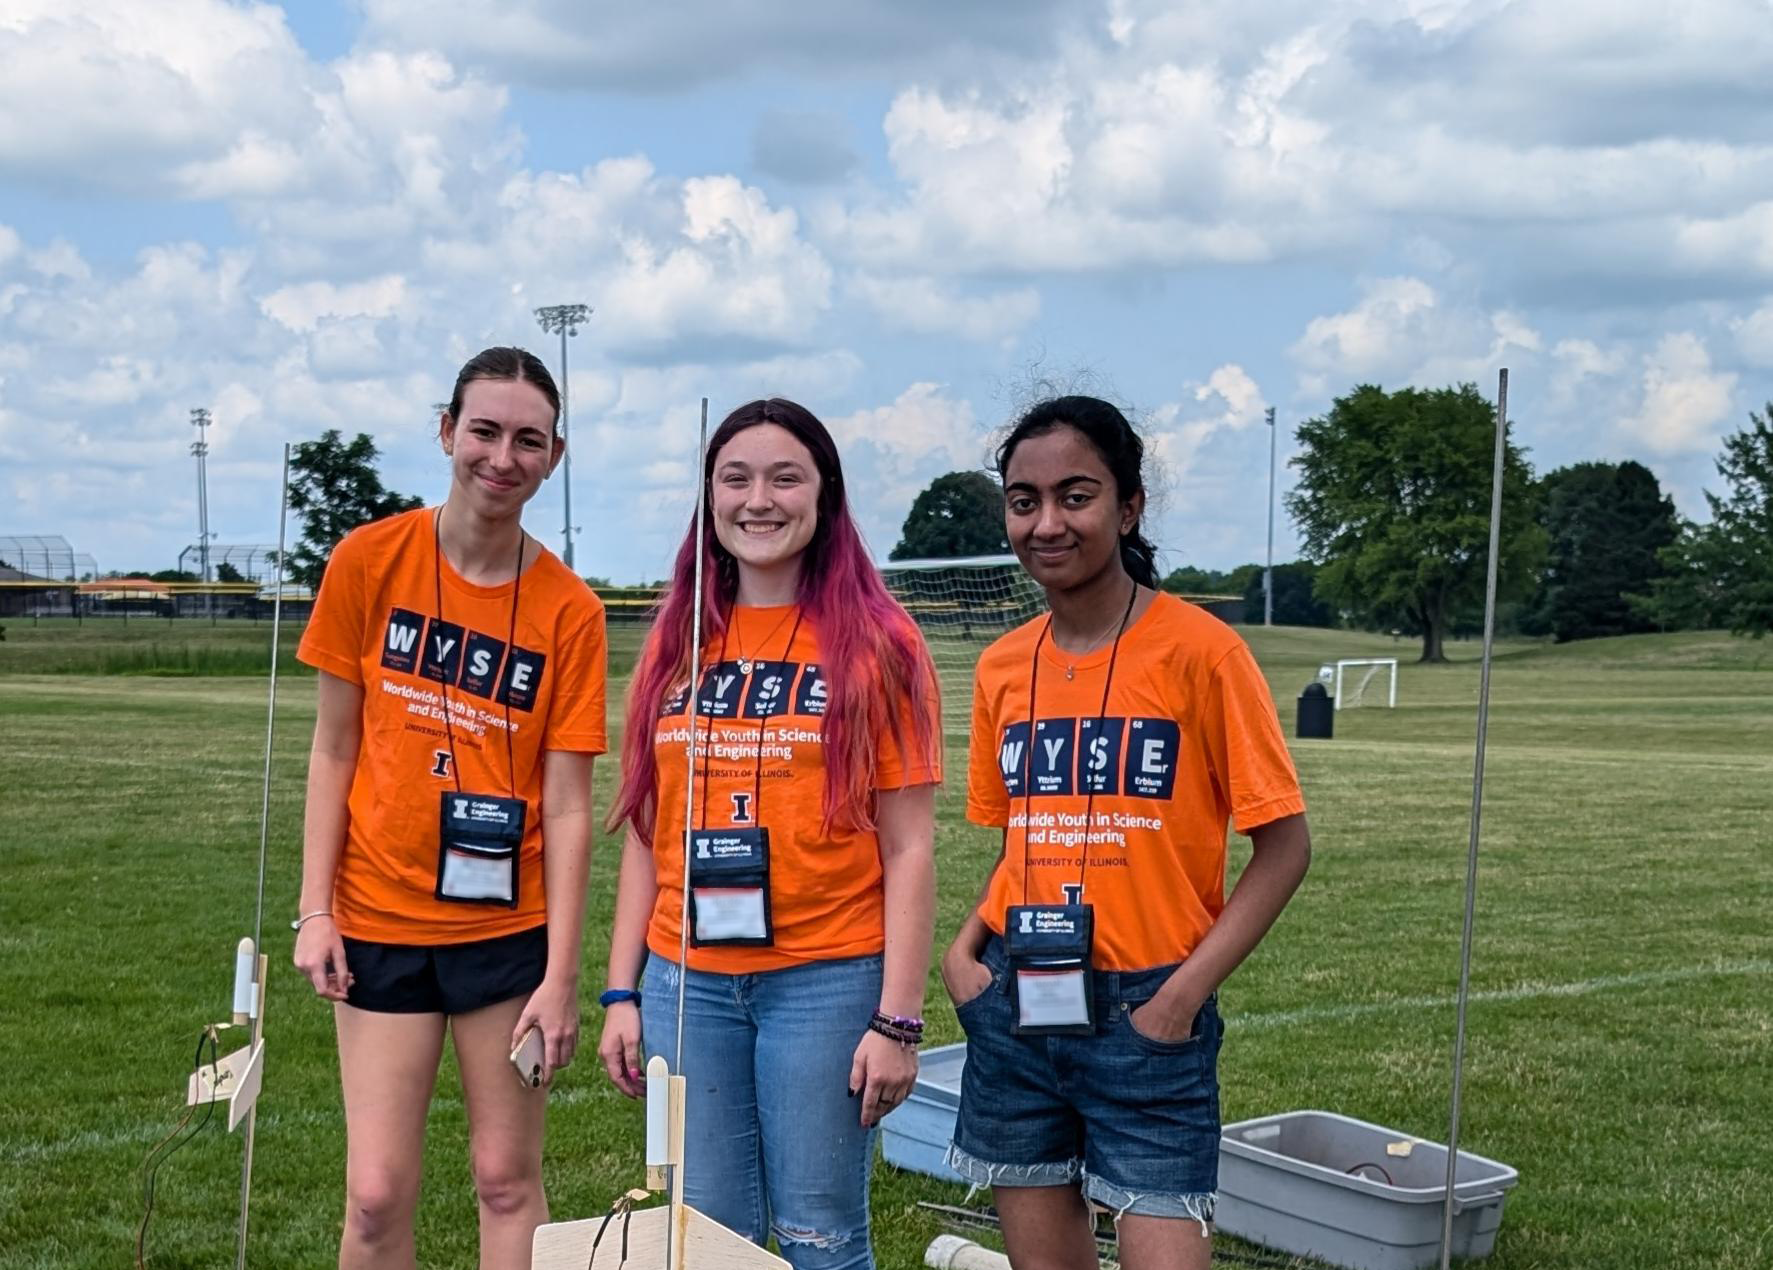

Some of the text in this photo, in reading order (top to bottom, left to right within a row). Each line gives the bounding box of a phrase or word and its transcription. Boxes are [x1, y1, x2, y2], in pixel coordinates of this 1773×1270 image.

[383, 680, 439, 704] Worldwide
[478, 710, 519, 733] Sciene
[407, 702, 429, 717] and
[1132, 720, 1143, 729] 68
[721, 729, 761, 743] Youth
[1134, 776, 1162, 787] Erbium
[730, 792, 752, 824] I
[1008, 811, 1055, 827] orldwide
[1096, 812, 1110, 826] in
[1113, 812, 1163, 831] Science
[712, 838, 741, 846] Grainger
[1049, 829, 1127, 848] Engineering
[712, 844, 752, 854] Engineering
[1036, 911, 1065, 921] Grainger
[1036, 919, 1075, 929] Engineering
